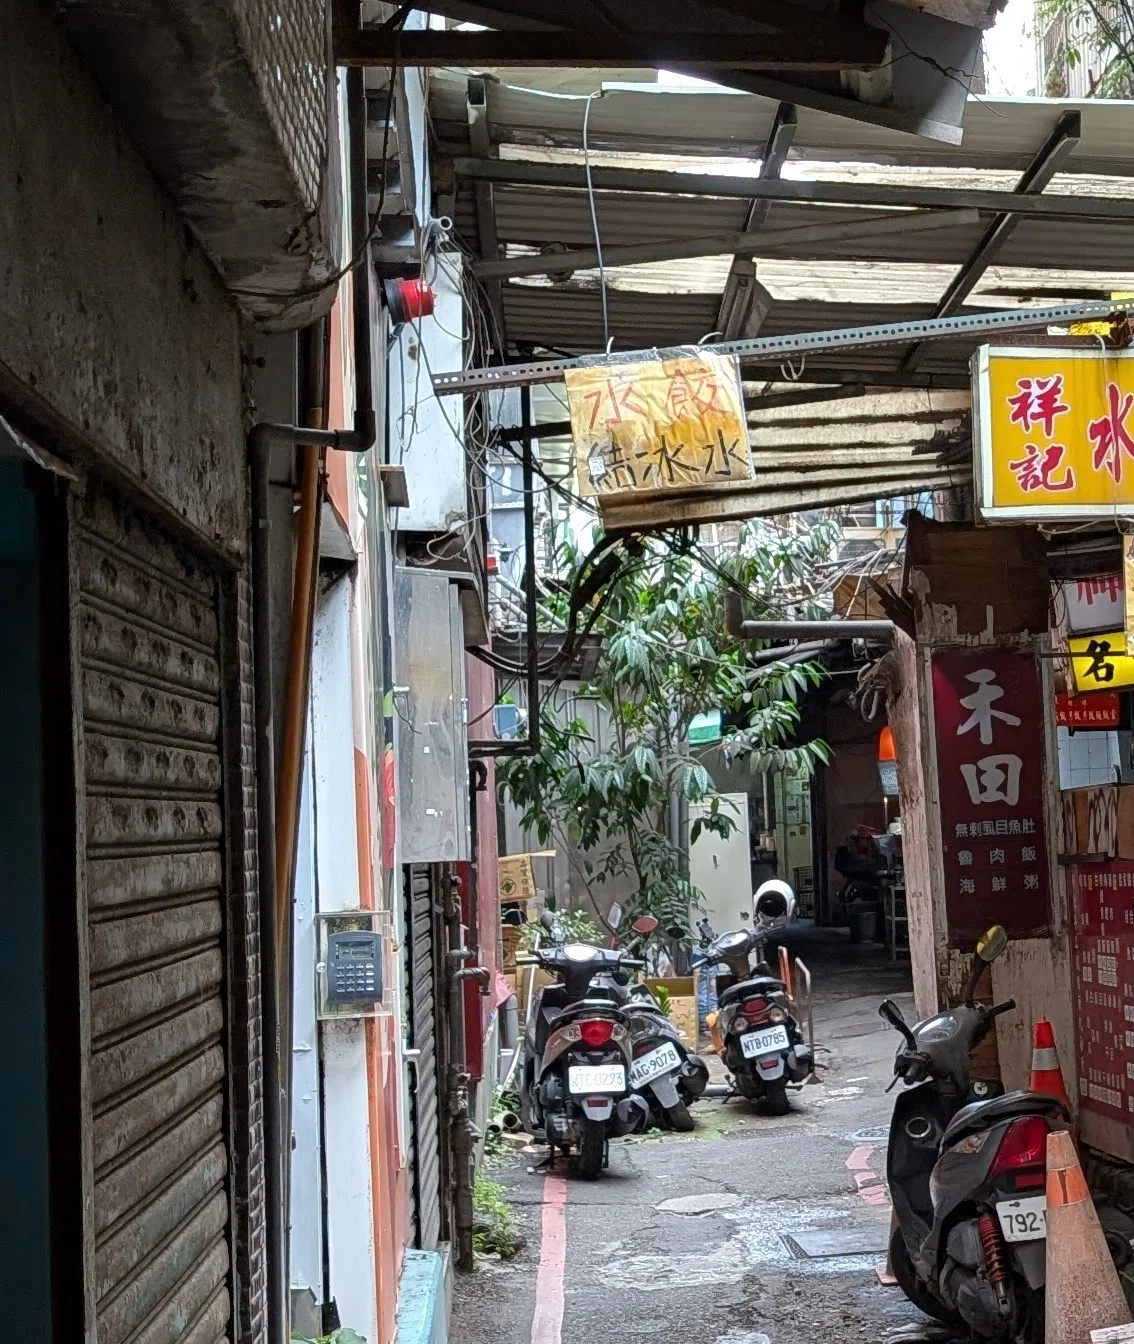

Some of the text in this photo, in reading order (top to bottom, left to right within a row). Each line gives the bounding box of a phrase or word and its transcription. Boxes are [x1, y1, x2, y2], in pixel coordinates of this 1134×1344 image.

[584, 368, 727, 430] 水餃
[1008, 373, 1076, 493] 祥記
[957, 669, 1023, 806] 禾田
[959, 873, 1039, 895] 海鮮粥
[1003, 1210, 1046, 1235] 792-
